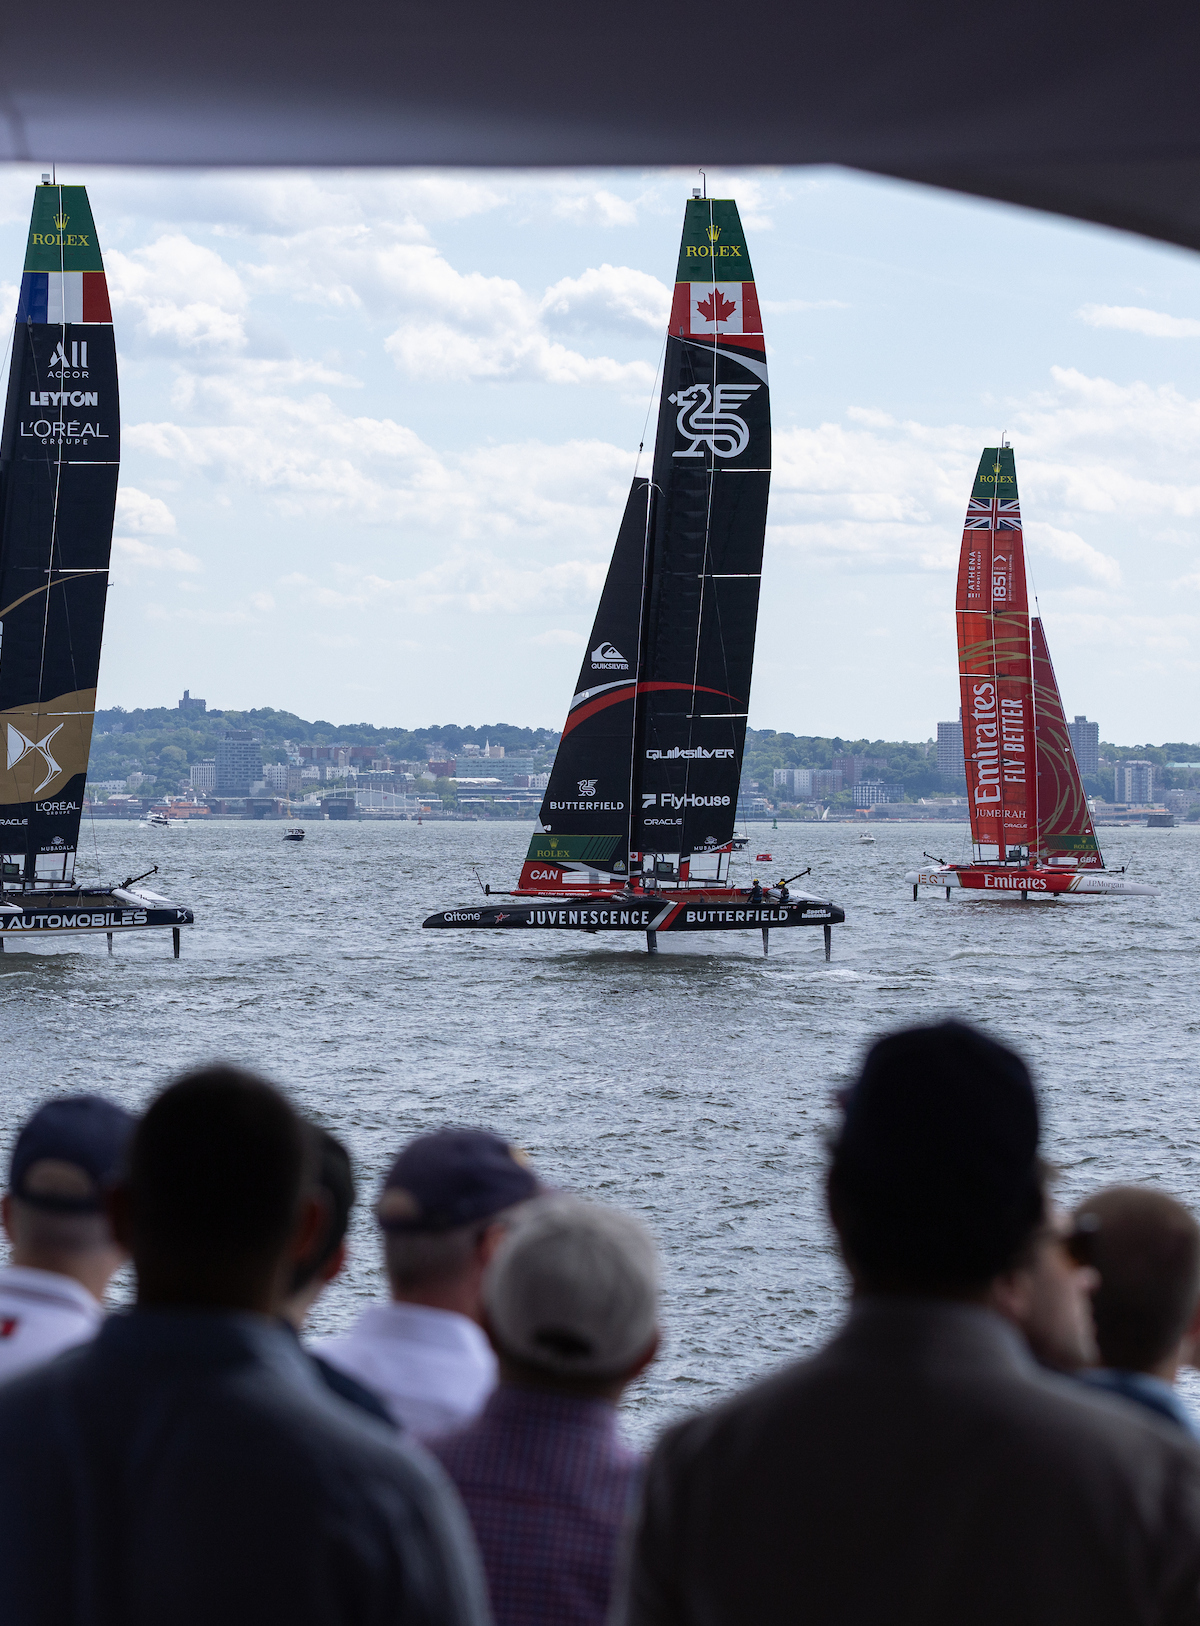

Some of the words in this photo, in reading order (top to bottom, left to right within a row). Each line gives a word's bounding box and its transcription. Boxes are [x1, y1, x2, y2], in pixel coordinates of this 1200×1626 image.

[31, 233, 90, 247] ROLEX
[685, 245, 742, 257] ROLEX
[47, 370, 90, 379] ACCOR
[29, 390, 98, 407] LEYTON
[20, 418, 109, 438] L'ORÉAL
[41, 438, 88, 446] GROUPE
[980, 475, 1014, 483] ROLEX
[968, 551, 976, 590] ATHENA
[590, 662, 629, 670] QUIKSILVER
[1001, 698, 1025, 752] BETTER
[971, 682, 1001, 805] Emirates
[1003, 758, 1026, 782] FLY
[550, 801, 624, 810] BUTTERFIELD
[660, 793, 731, 810] FlyHouse
[644, 818, 683, 826] ORACLE
[536, 850, 570, 858] ROLEX
[1080, 856, 1098, 864] GBR
[530, 870, 559, 880] CAN
[984, 874, 1047, 890] Emirates
[7, 911, 148, 930] AUTOMOBILES
[526, 910, 650, 925] JUVENESCENCE
[686, 910, 789, 923] BUTTERFIELD
